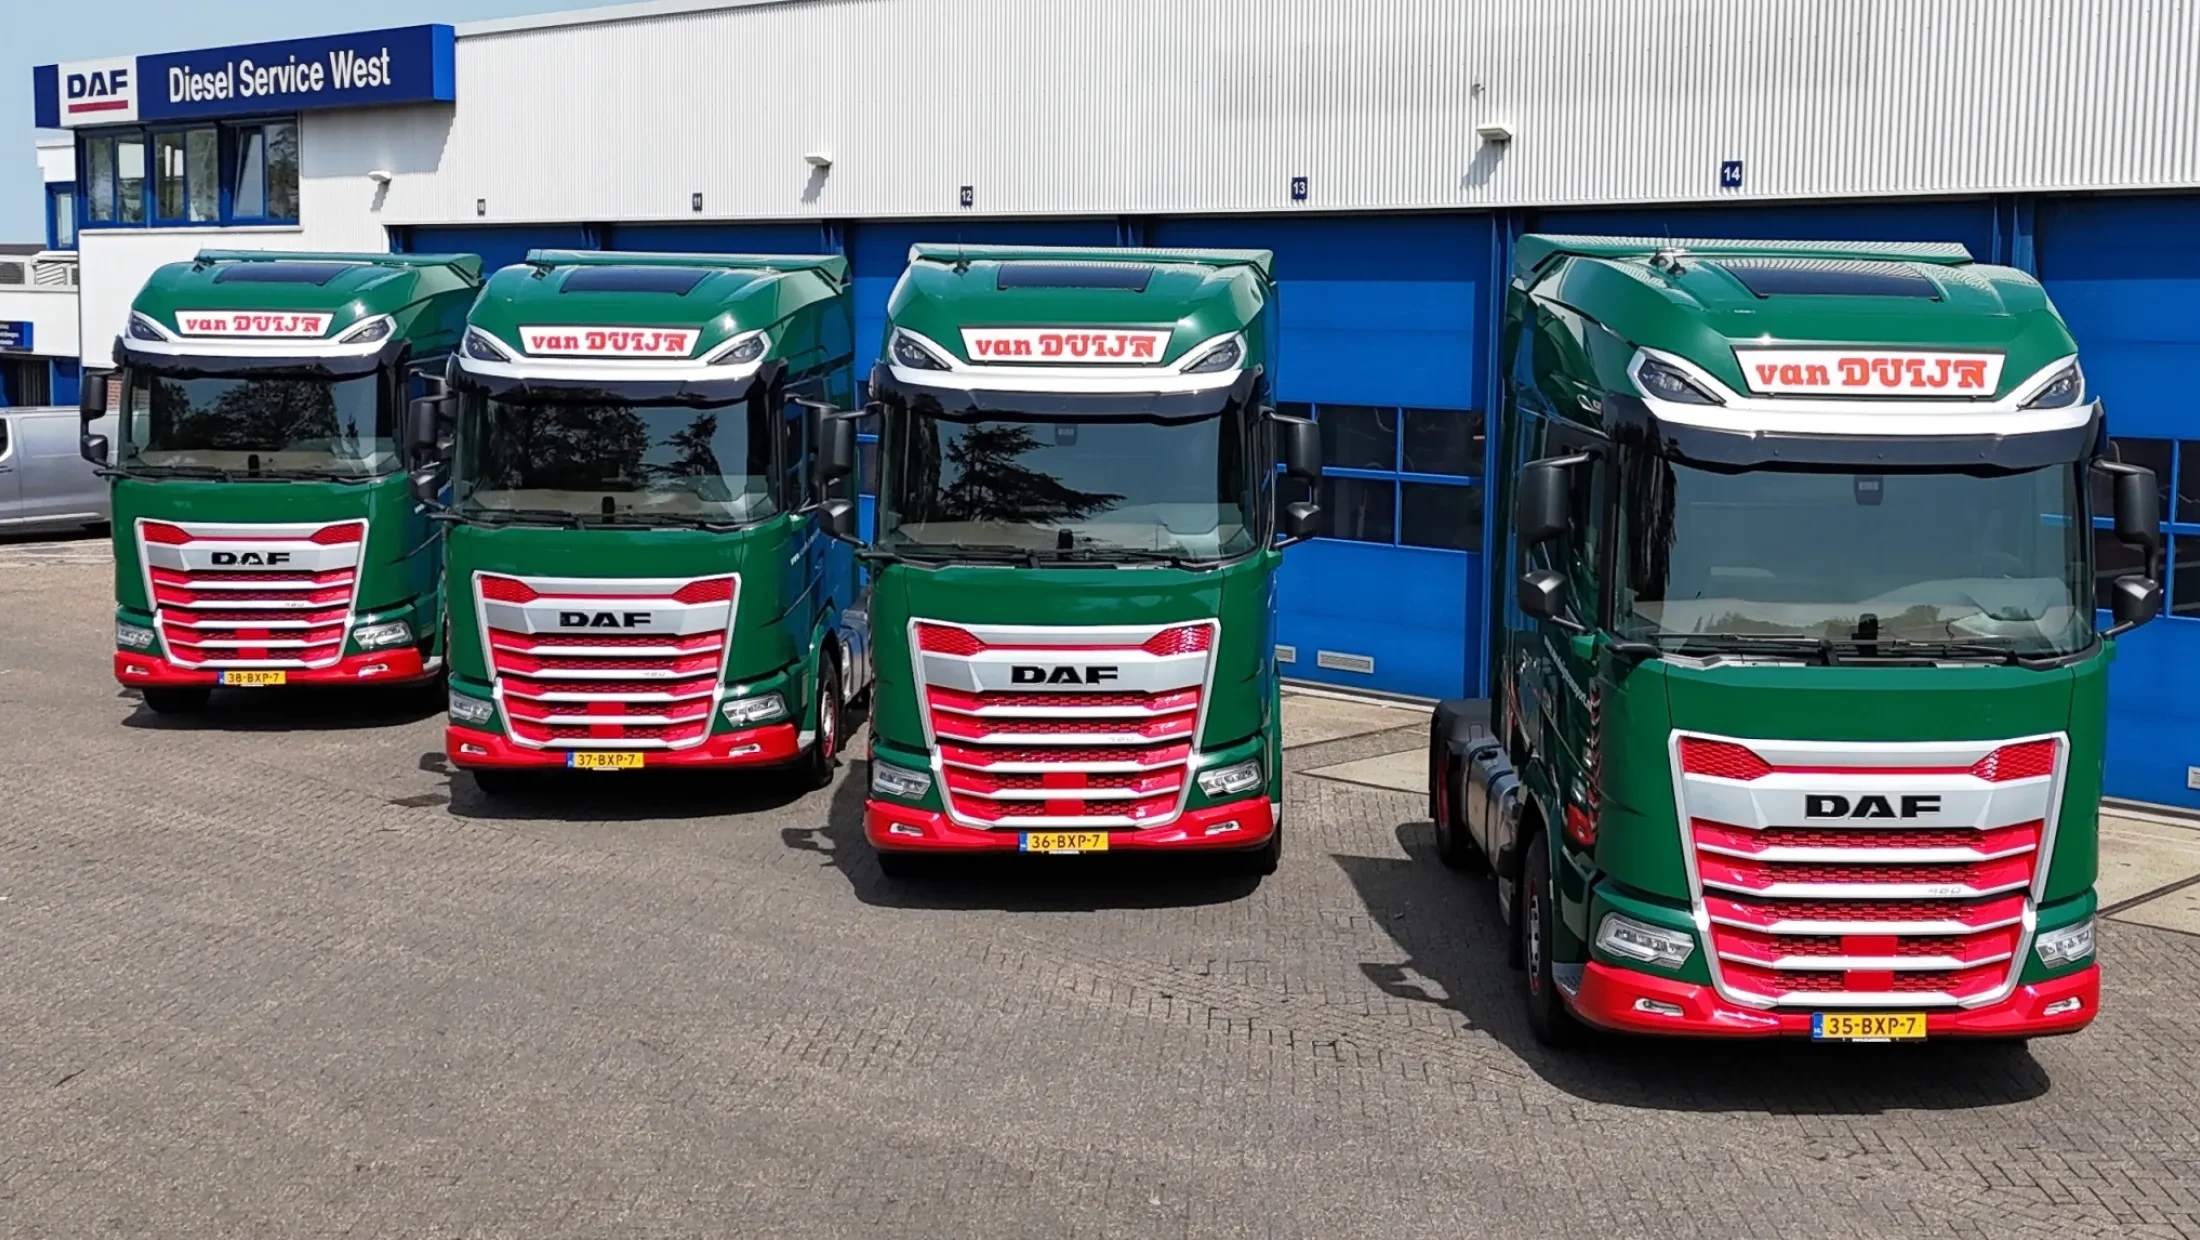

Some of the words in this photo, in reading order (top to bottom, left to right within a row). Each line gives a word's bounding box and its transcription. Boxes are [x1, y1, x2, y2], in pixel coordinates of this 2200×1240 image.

[66, 68, 128, 99] DAF
[168, 62, 234, 103] Diesel
[239, 55, 324, 97] Service
[329, 47, 391, 89] West
[1723, 166, 1741, 181] 14
[961, 189, 972, 202] 12
[1293, 181, 1306, 195] 13
[185, 318, 228, 331] van
[233, 315, 322, 332] DUIJN
[531, 335, 580, 350] van
[585, 331, 688, 352] DUIJN
[975, 339, 1032, 356] van
[1038, 333, 1157, 357] DUIJN
[1755, 363, 1831, 386] van
[1837, 357, 1988, 388] DUIJN
[211, 551, 291, 566] DAF
[559, 611, 652, 628] DAF
[227, 672, 280, 683] 38-BXP-7
[1010, 665, 1119, 685] DAF
[577, 754, 636, 766] 37-BXP-7
[1804, 794, 1942, 820] DAF
[1031, 834, 1101, 849] 36-BXP-7
[1828, 1017, 1917, 1035] 35-BXP-7
